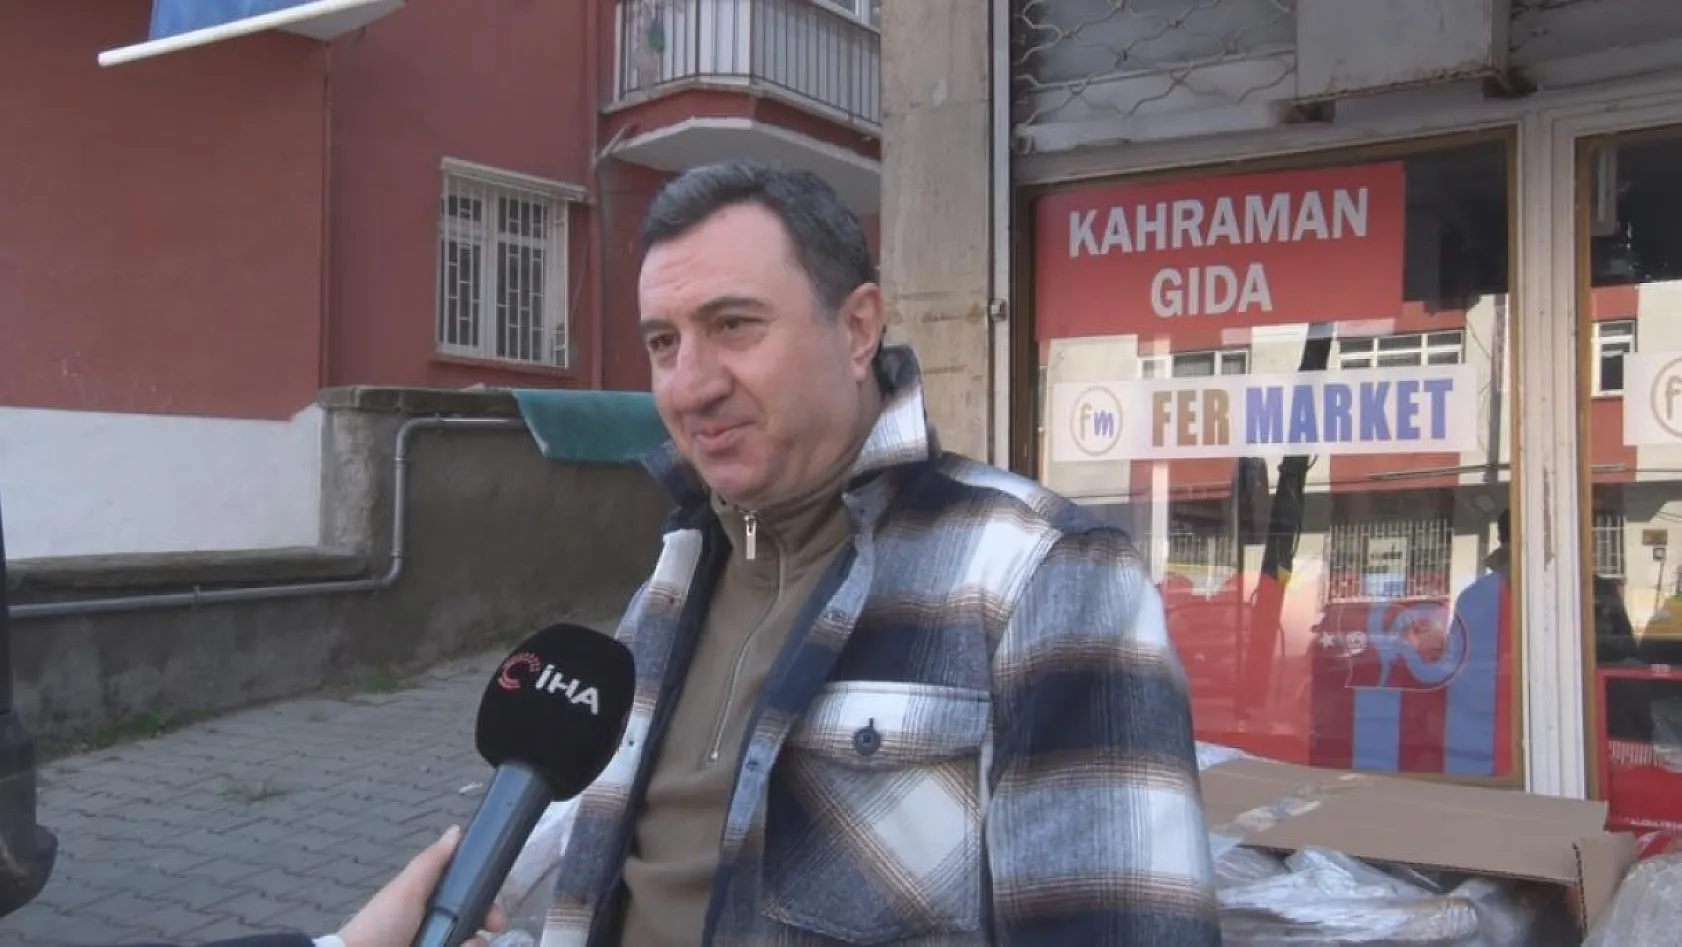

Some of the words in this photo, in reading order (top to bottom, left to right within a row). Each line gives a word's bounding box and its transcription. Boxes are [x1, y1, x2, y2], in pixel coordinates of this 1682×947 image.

[1069, 188, 1368, 258] KAHRAMAN
[1151, 262, 1273, 318] GIDA
[1152, 388, 1230, 447] FER
[1246, 378, 1454, 444] MARKET
